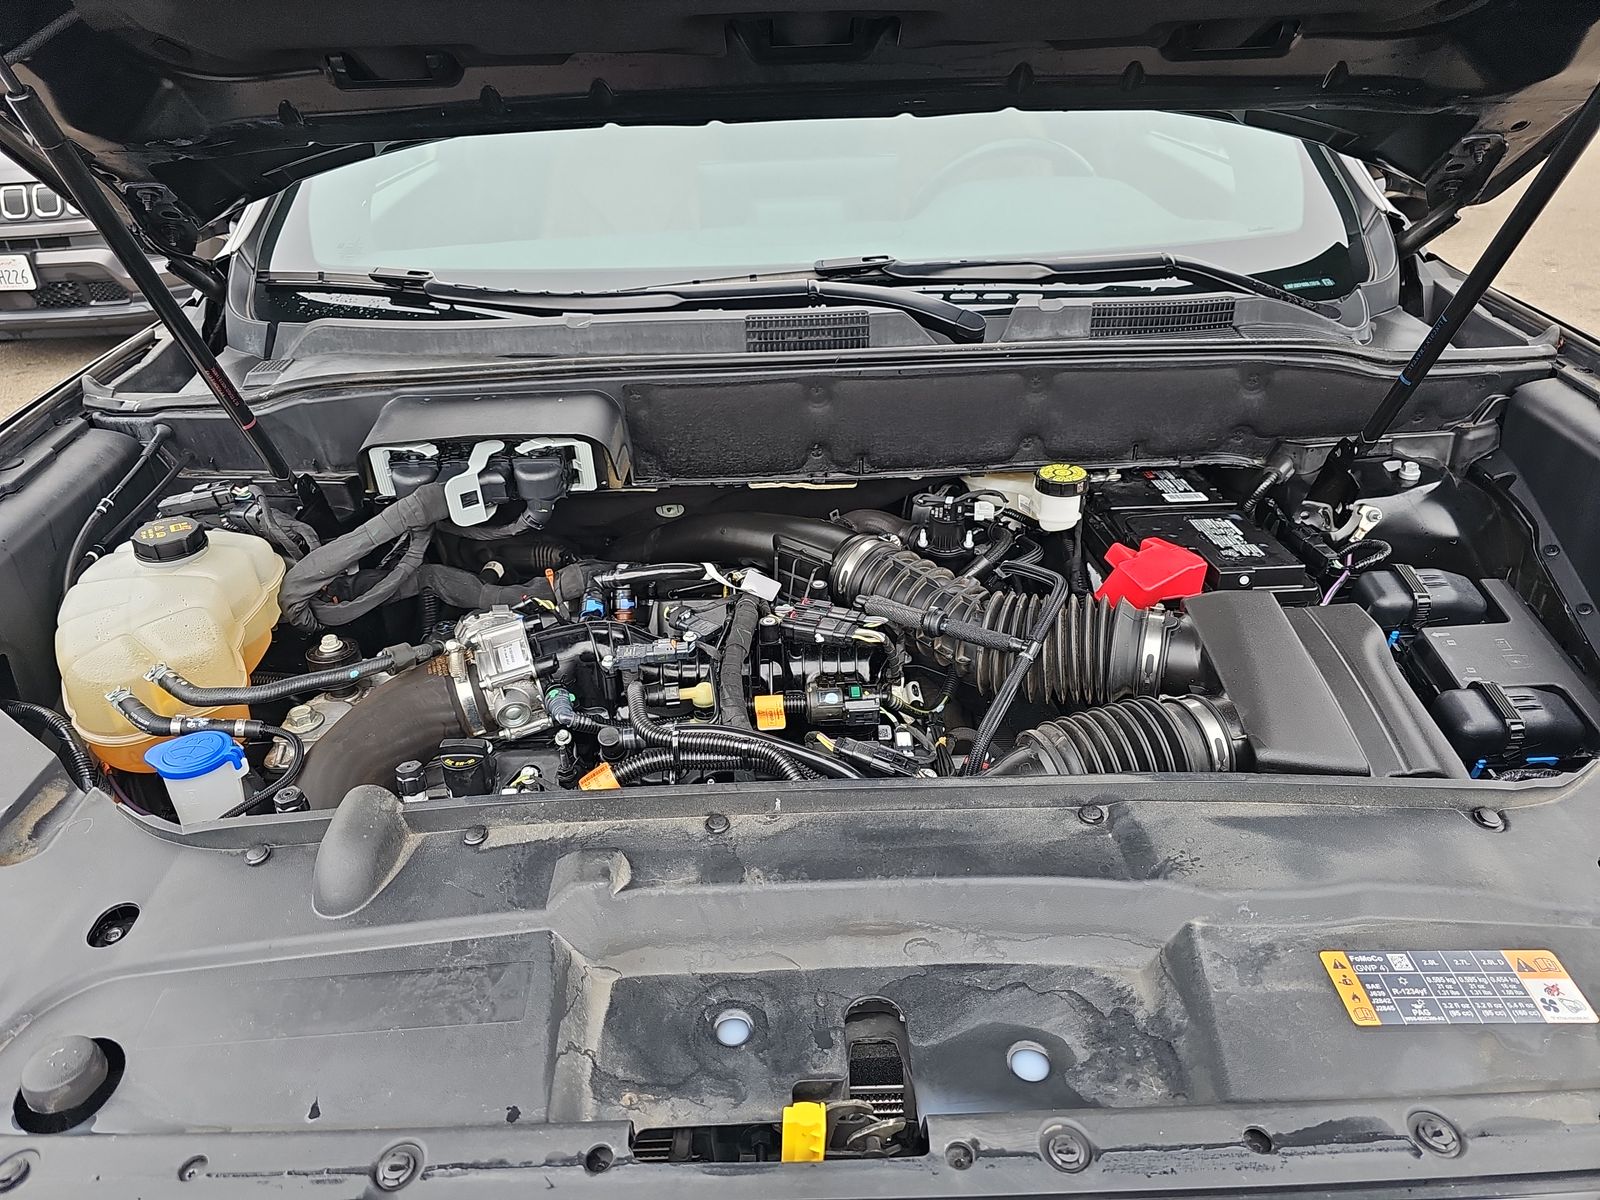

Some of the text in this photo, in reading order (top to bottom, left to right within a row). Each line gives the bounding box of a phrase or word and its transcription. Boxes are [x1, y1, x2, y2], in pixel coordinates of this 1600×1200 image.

[1353, 964, 1389, 973] (GWP 4)
[1392, 988, 1427, 996] R-1234yf
